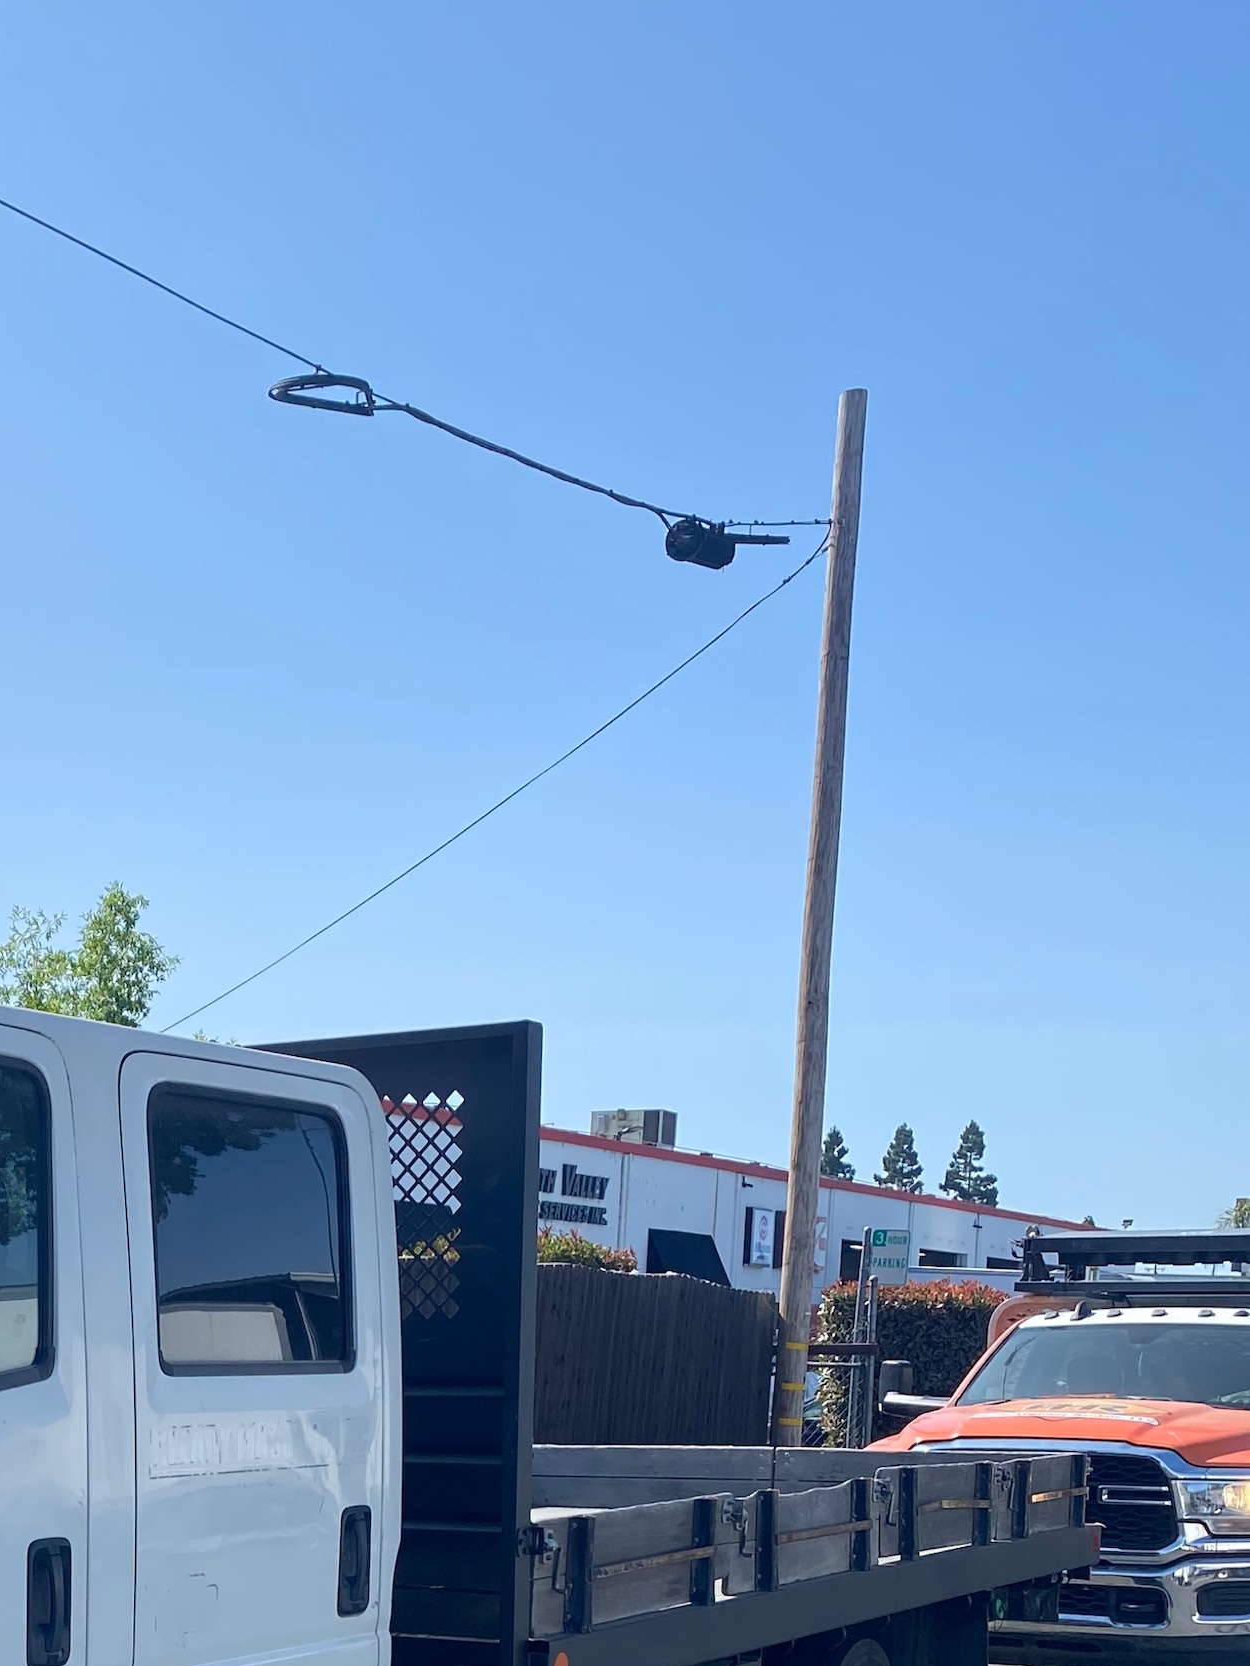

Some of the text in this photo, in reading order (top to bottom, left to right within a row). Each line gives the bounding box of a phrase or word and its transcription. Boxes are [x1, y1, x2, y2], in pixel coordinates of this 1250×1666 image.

[540, 1201, 588, 1223] SERVICES
[875, 1231, 908, 1245] 3 HOUR
[872, 1257, 906, 1269] PARKING
